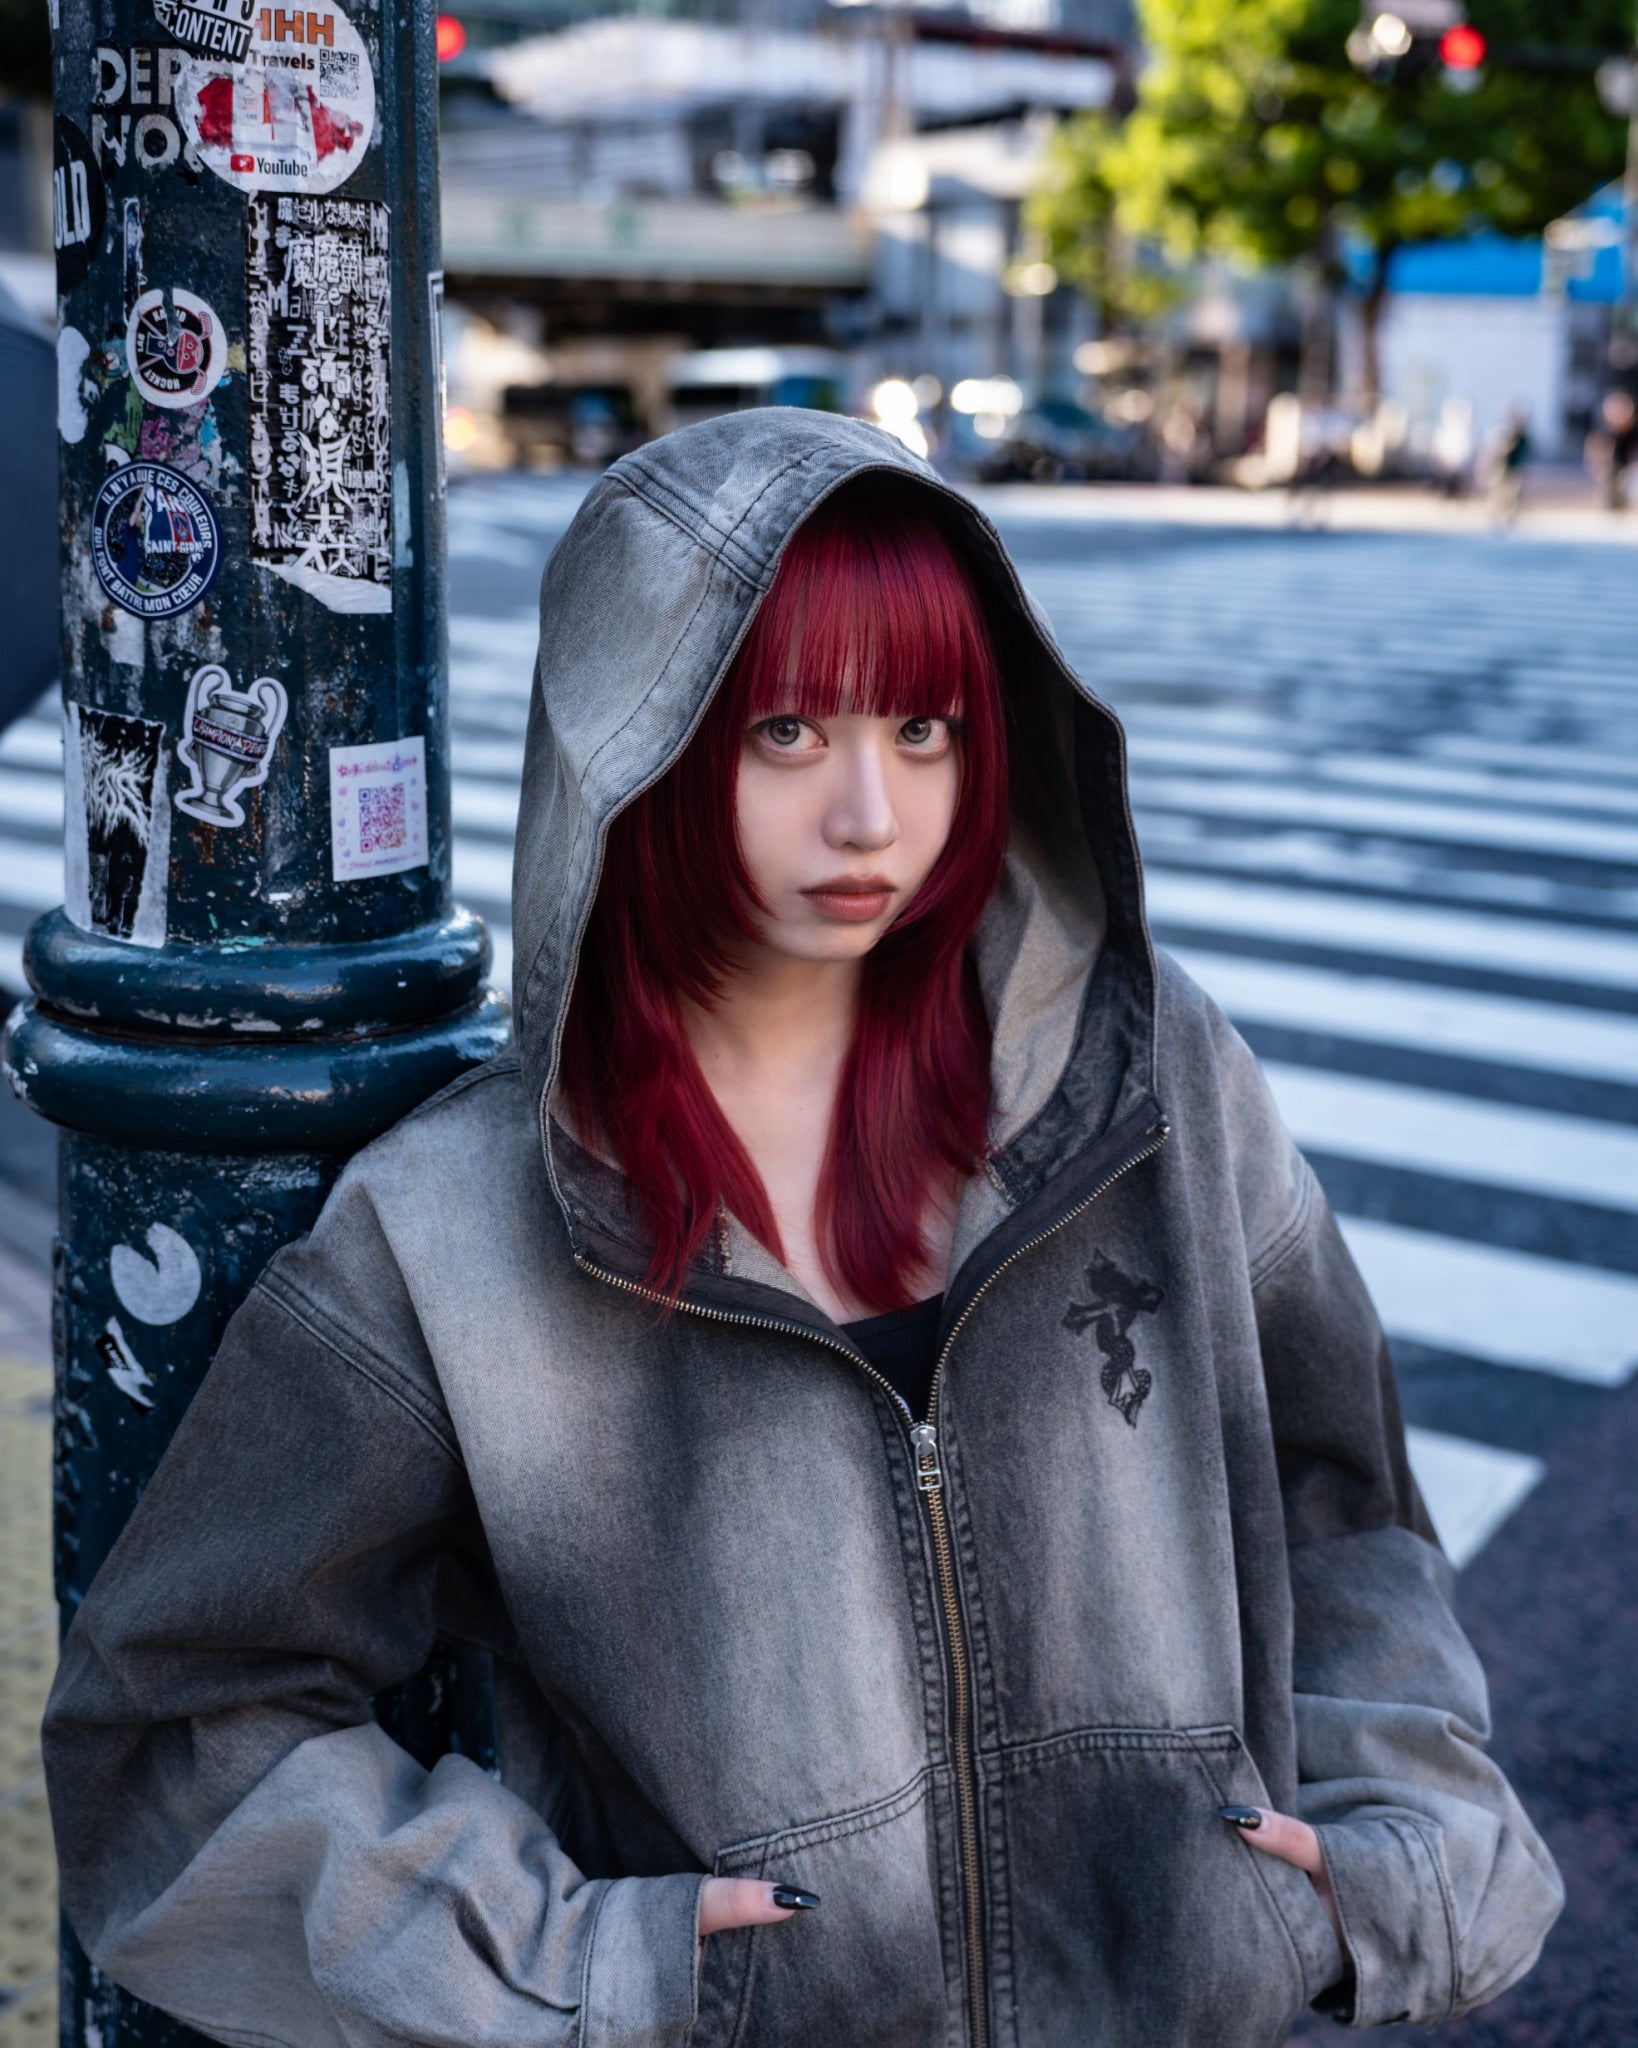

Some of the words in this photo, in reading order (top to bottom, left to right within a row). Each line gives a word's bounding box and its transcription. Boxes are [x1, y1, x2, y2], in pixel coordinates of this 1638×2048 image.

[256, 157, 309, 178] YouTube
[143, 368, 181, 390] HOCKEY
[156, 472, 180, 493] CES
[177, 487, 212, 549] COULEURS
